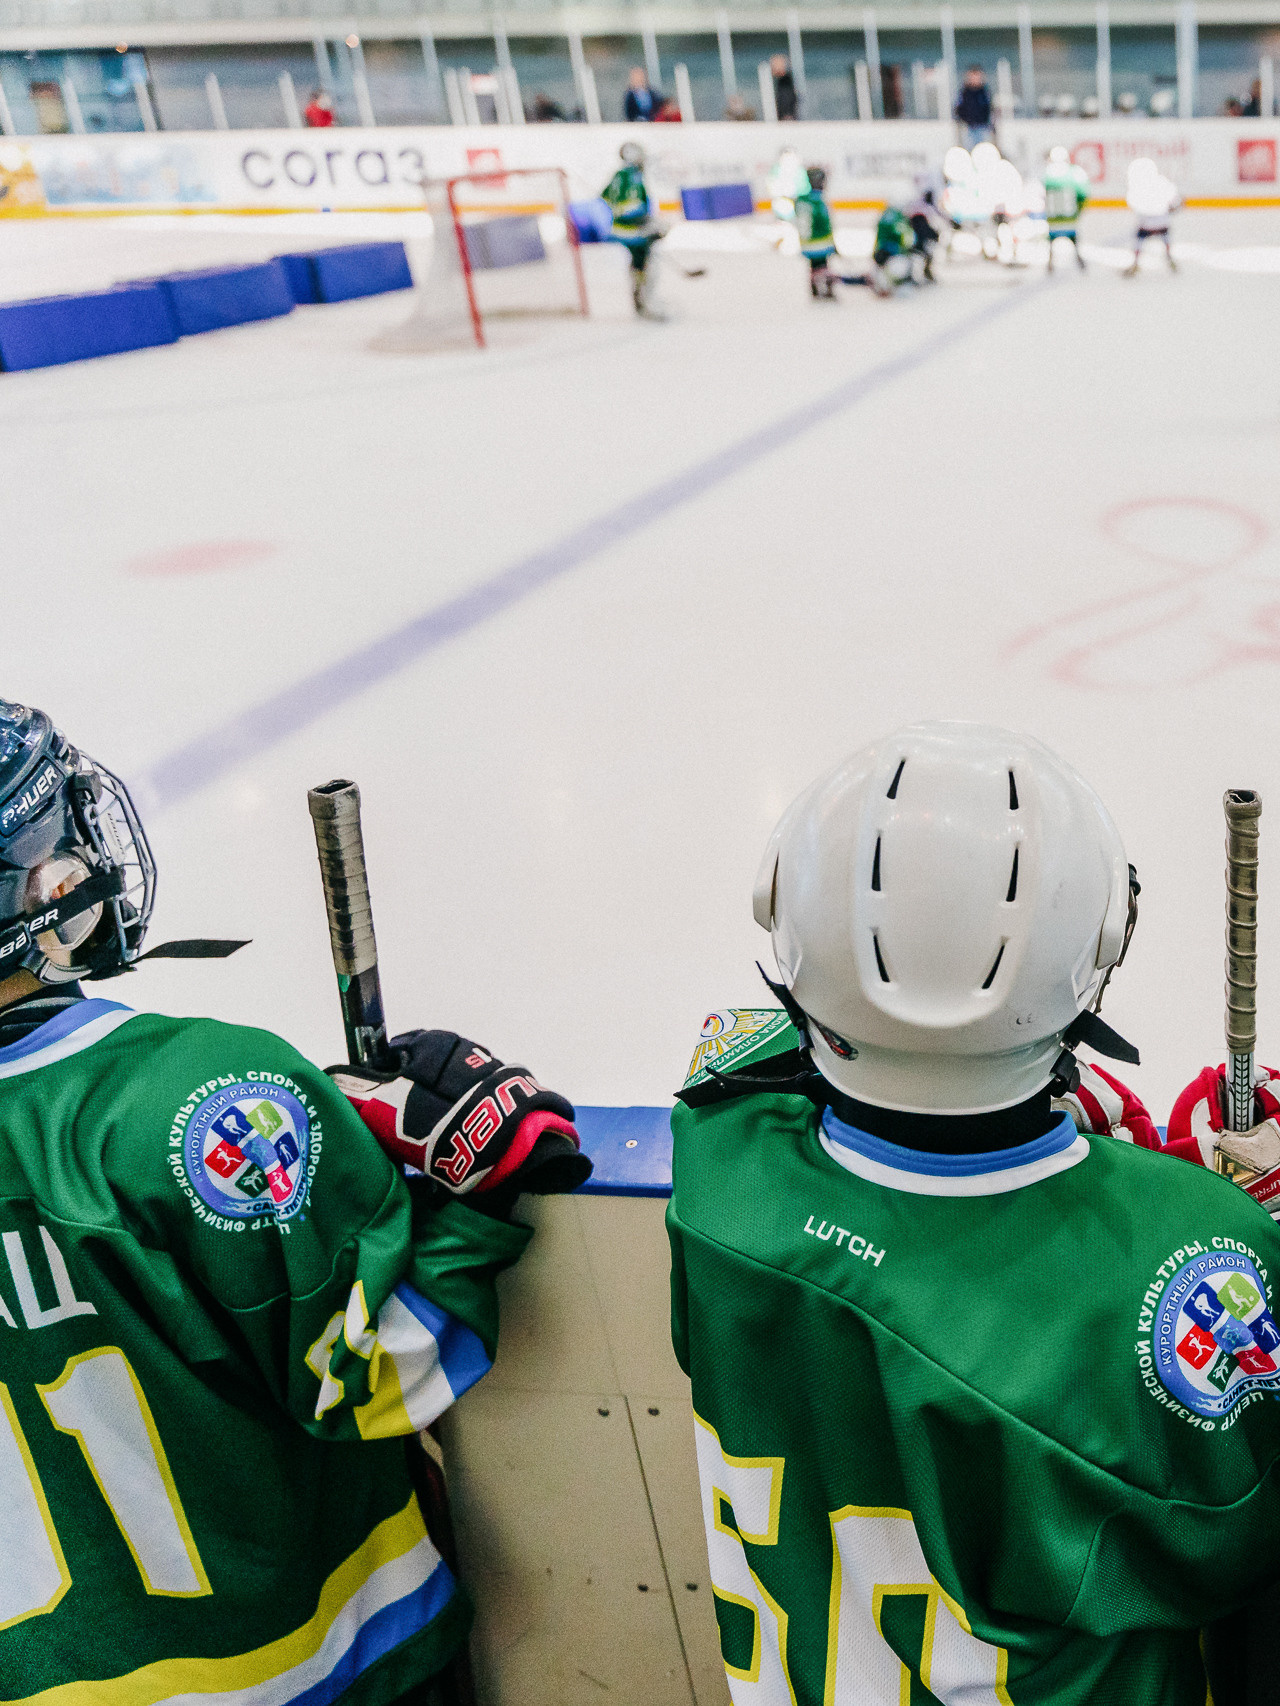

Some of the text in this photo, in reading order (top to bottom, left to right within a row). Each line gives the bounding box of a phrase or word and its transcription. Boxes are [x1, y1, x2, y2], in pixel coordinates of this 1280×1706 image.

[240, 146, 425, 189] согаз
[803, 1214, 887, 1269] LUTCH
[1134, 1338, 1216, 1433] ФИЗИЧЕСКОЙ
[1211, 1236, 1269, 1283] СПОРТА
[1161, 1254, 1247, 1367] КУРОРТНЫЙ РАЙОН
